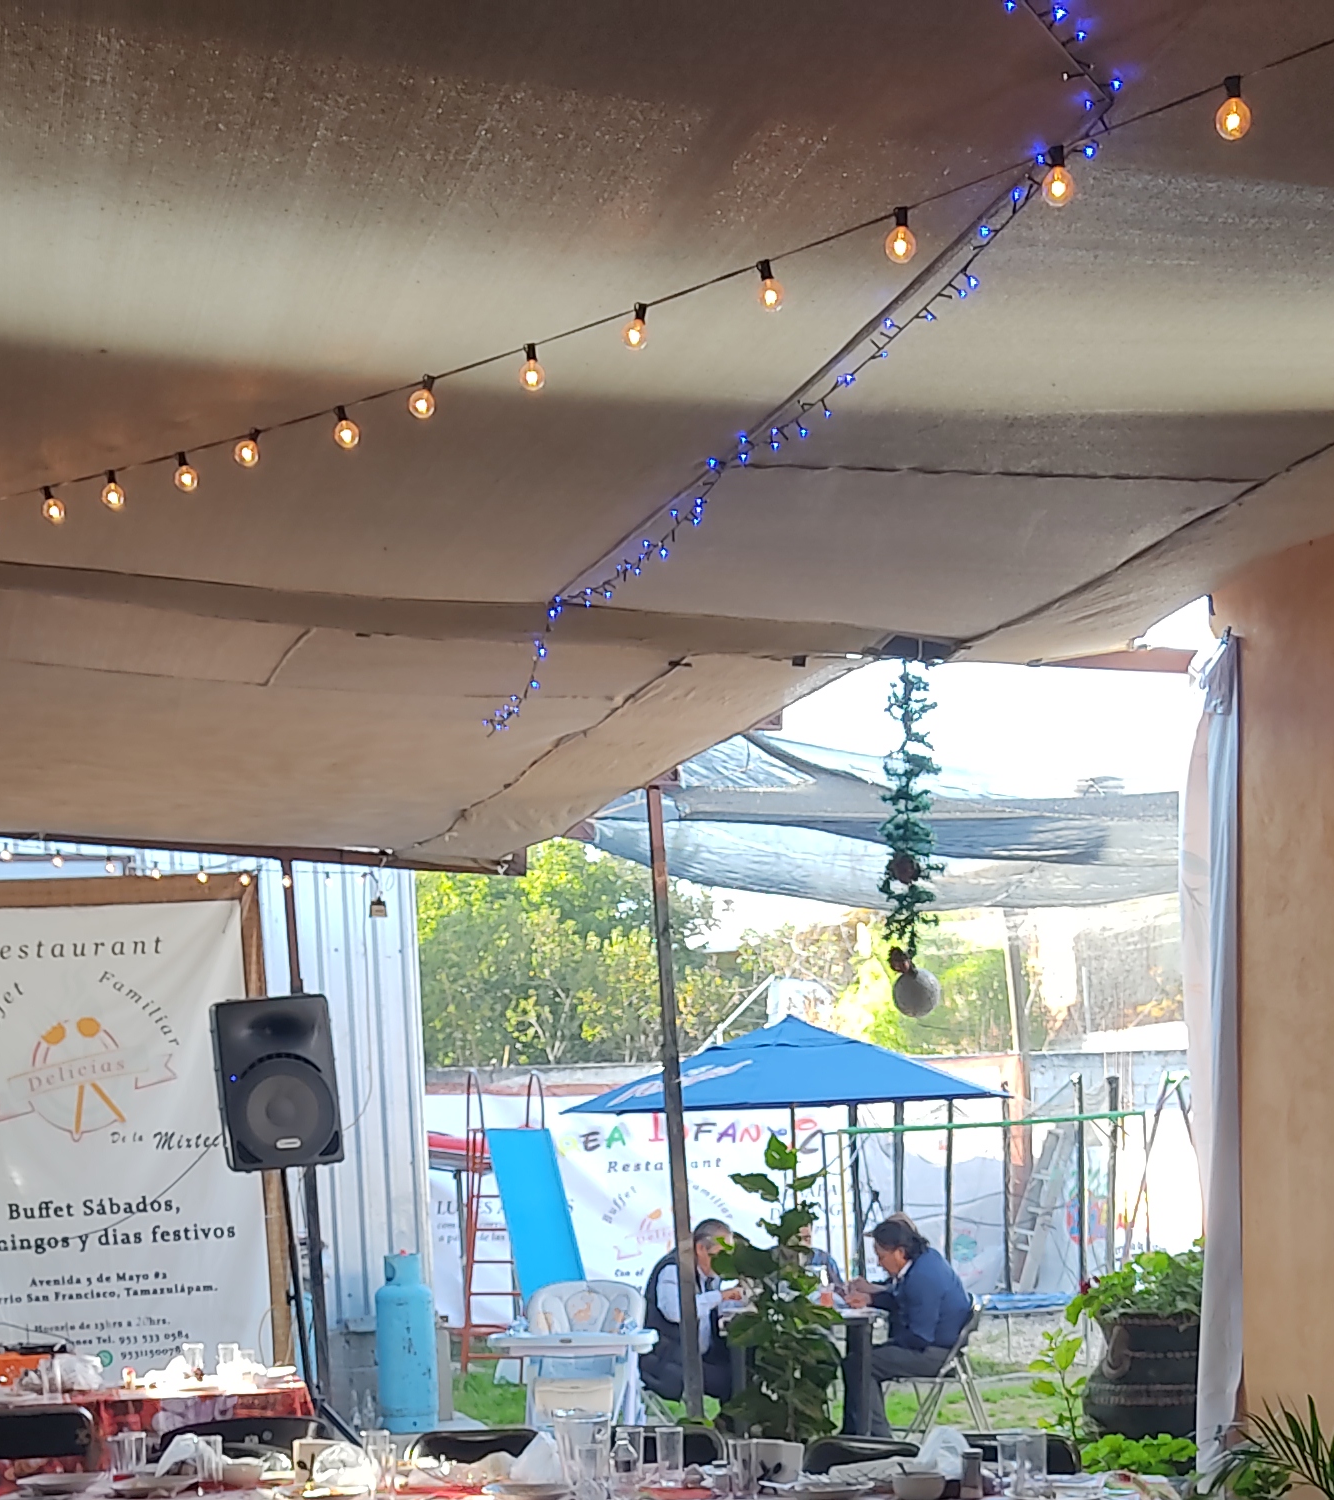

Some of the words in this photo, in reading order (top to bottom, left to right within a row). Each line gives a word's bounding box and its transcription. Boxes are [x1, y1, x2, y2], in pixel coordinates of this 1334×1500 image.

[98, 970, 180, 1047] Familiar
[28, 1060, 126, 1092] Delicias
[110, 1131, 127, 1144] De
[132, 1131, 143, 1143] la
[607, 1157, 722, 1174] Restaant
[8, 1200, 75, 1220] Buffet
[83, 1195, 181, 1217] Sábados,
[78, 1233, 89, 1252] y
[151, 1223, 236, 1243] festivos
[29, 1275, 82, 1288] Avenida
[97, 1273, 111, 1284] de
[116, 1272, 149, 1284] Mayo
[26, 1293, 50, 1304] San
[54, 1288, 121, 1302] Francisco,
